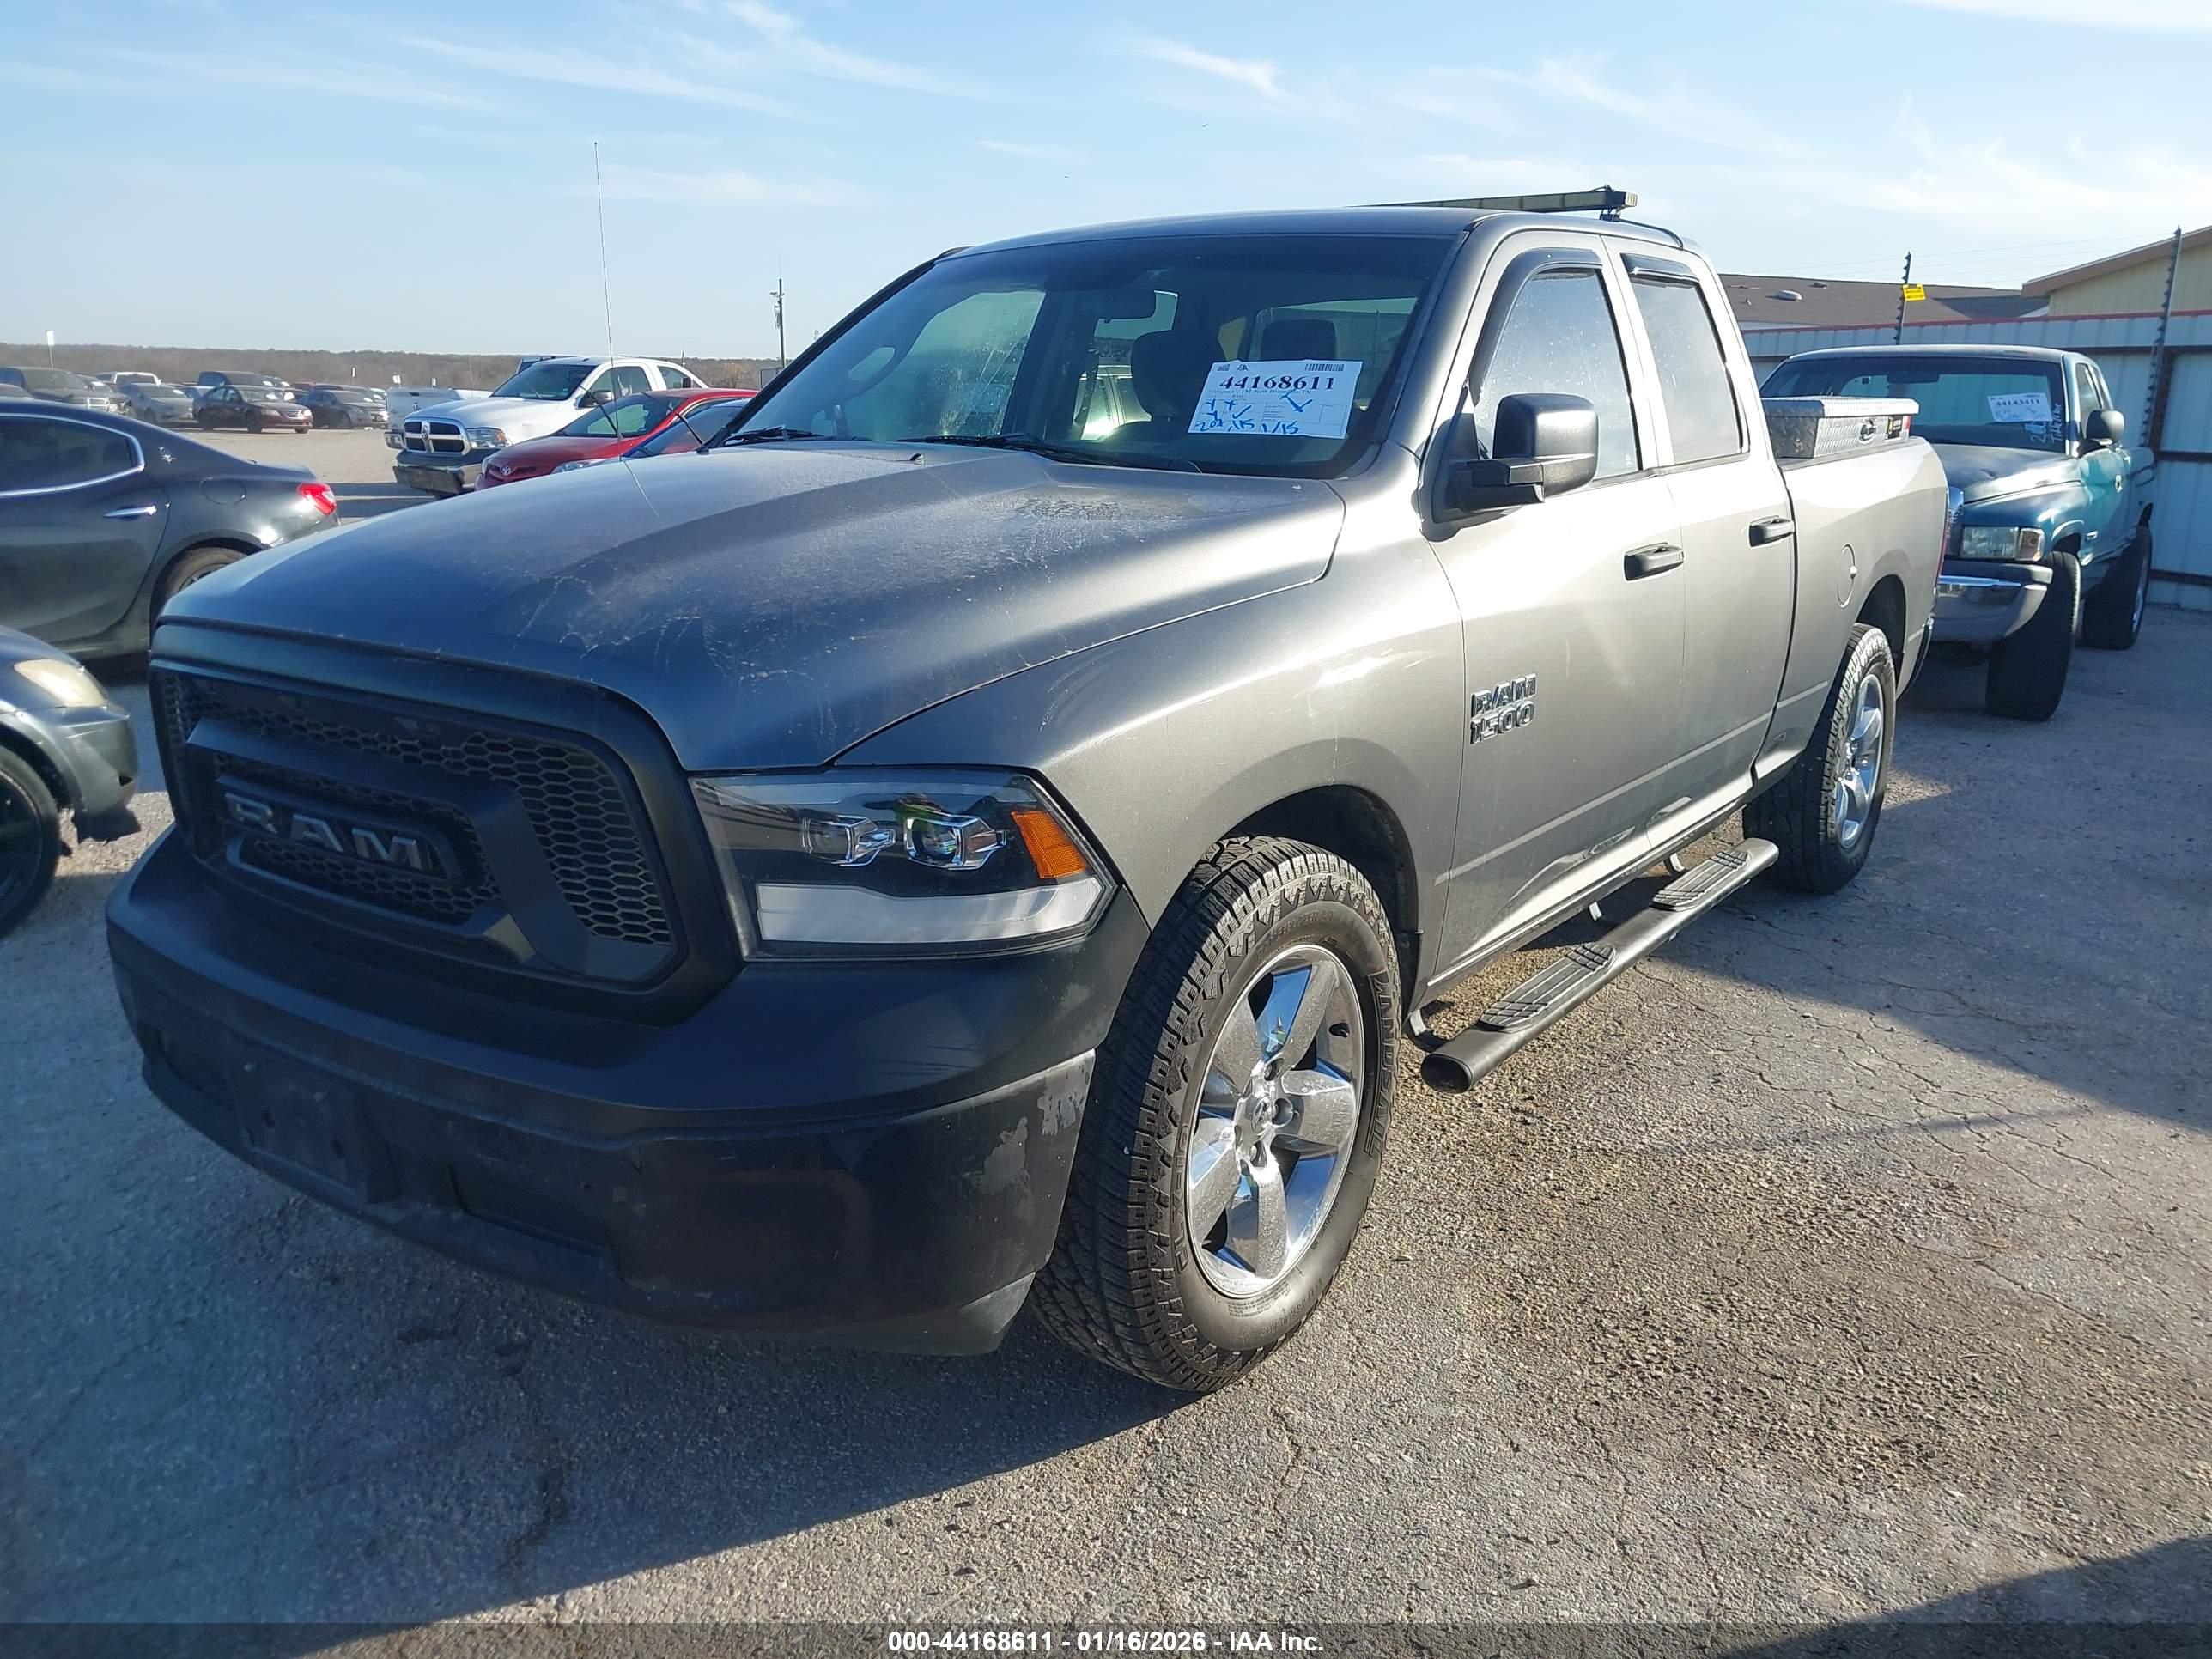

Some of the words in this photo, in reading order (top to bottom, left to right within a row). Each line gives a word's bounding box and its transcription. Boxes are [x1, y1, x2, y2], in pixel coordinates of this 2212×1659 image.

[1219, 375, 1331, 390] 44168611
[1471, 673, 1537, 719] RAM
[1470, 700, 1535, 744] 1500
[225, 792, 424, 872] RAM
